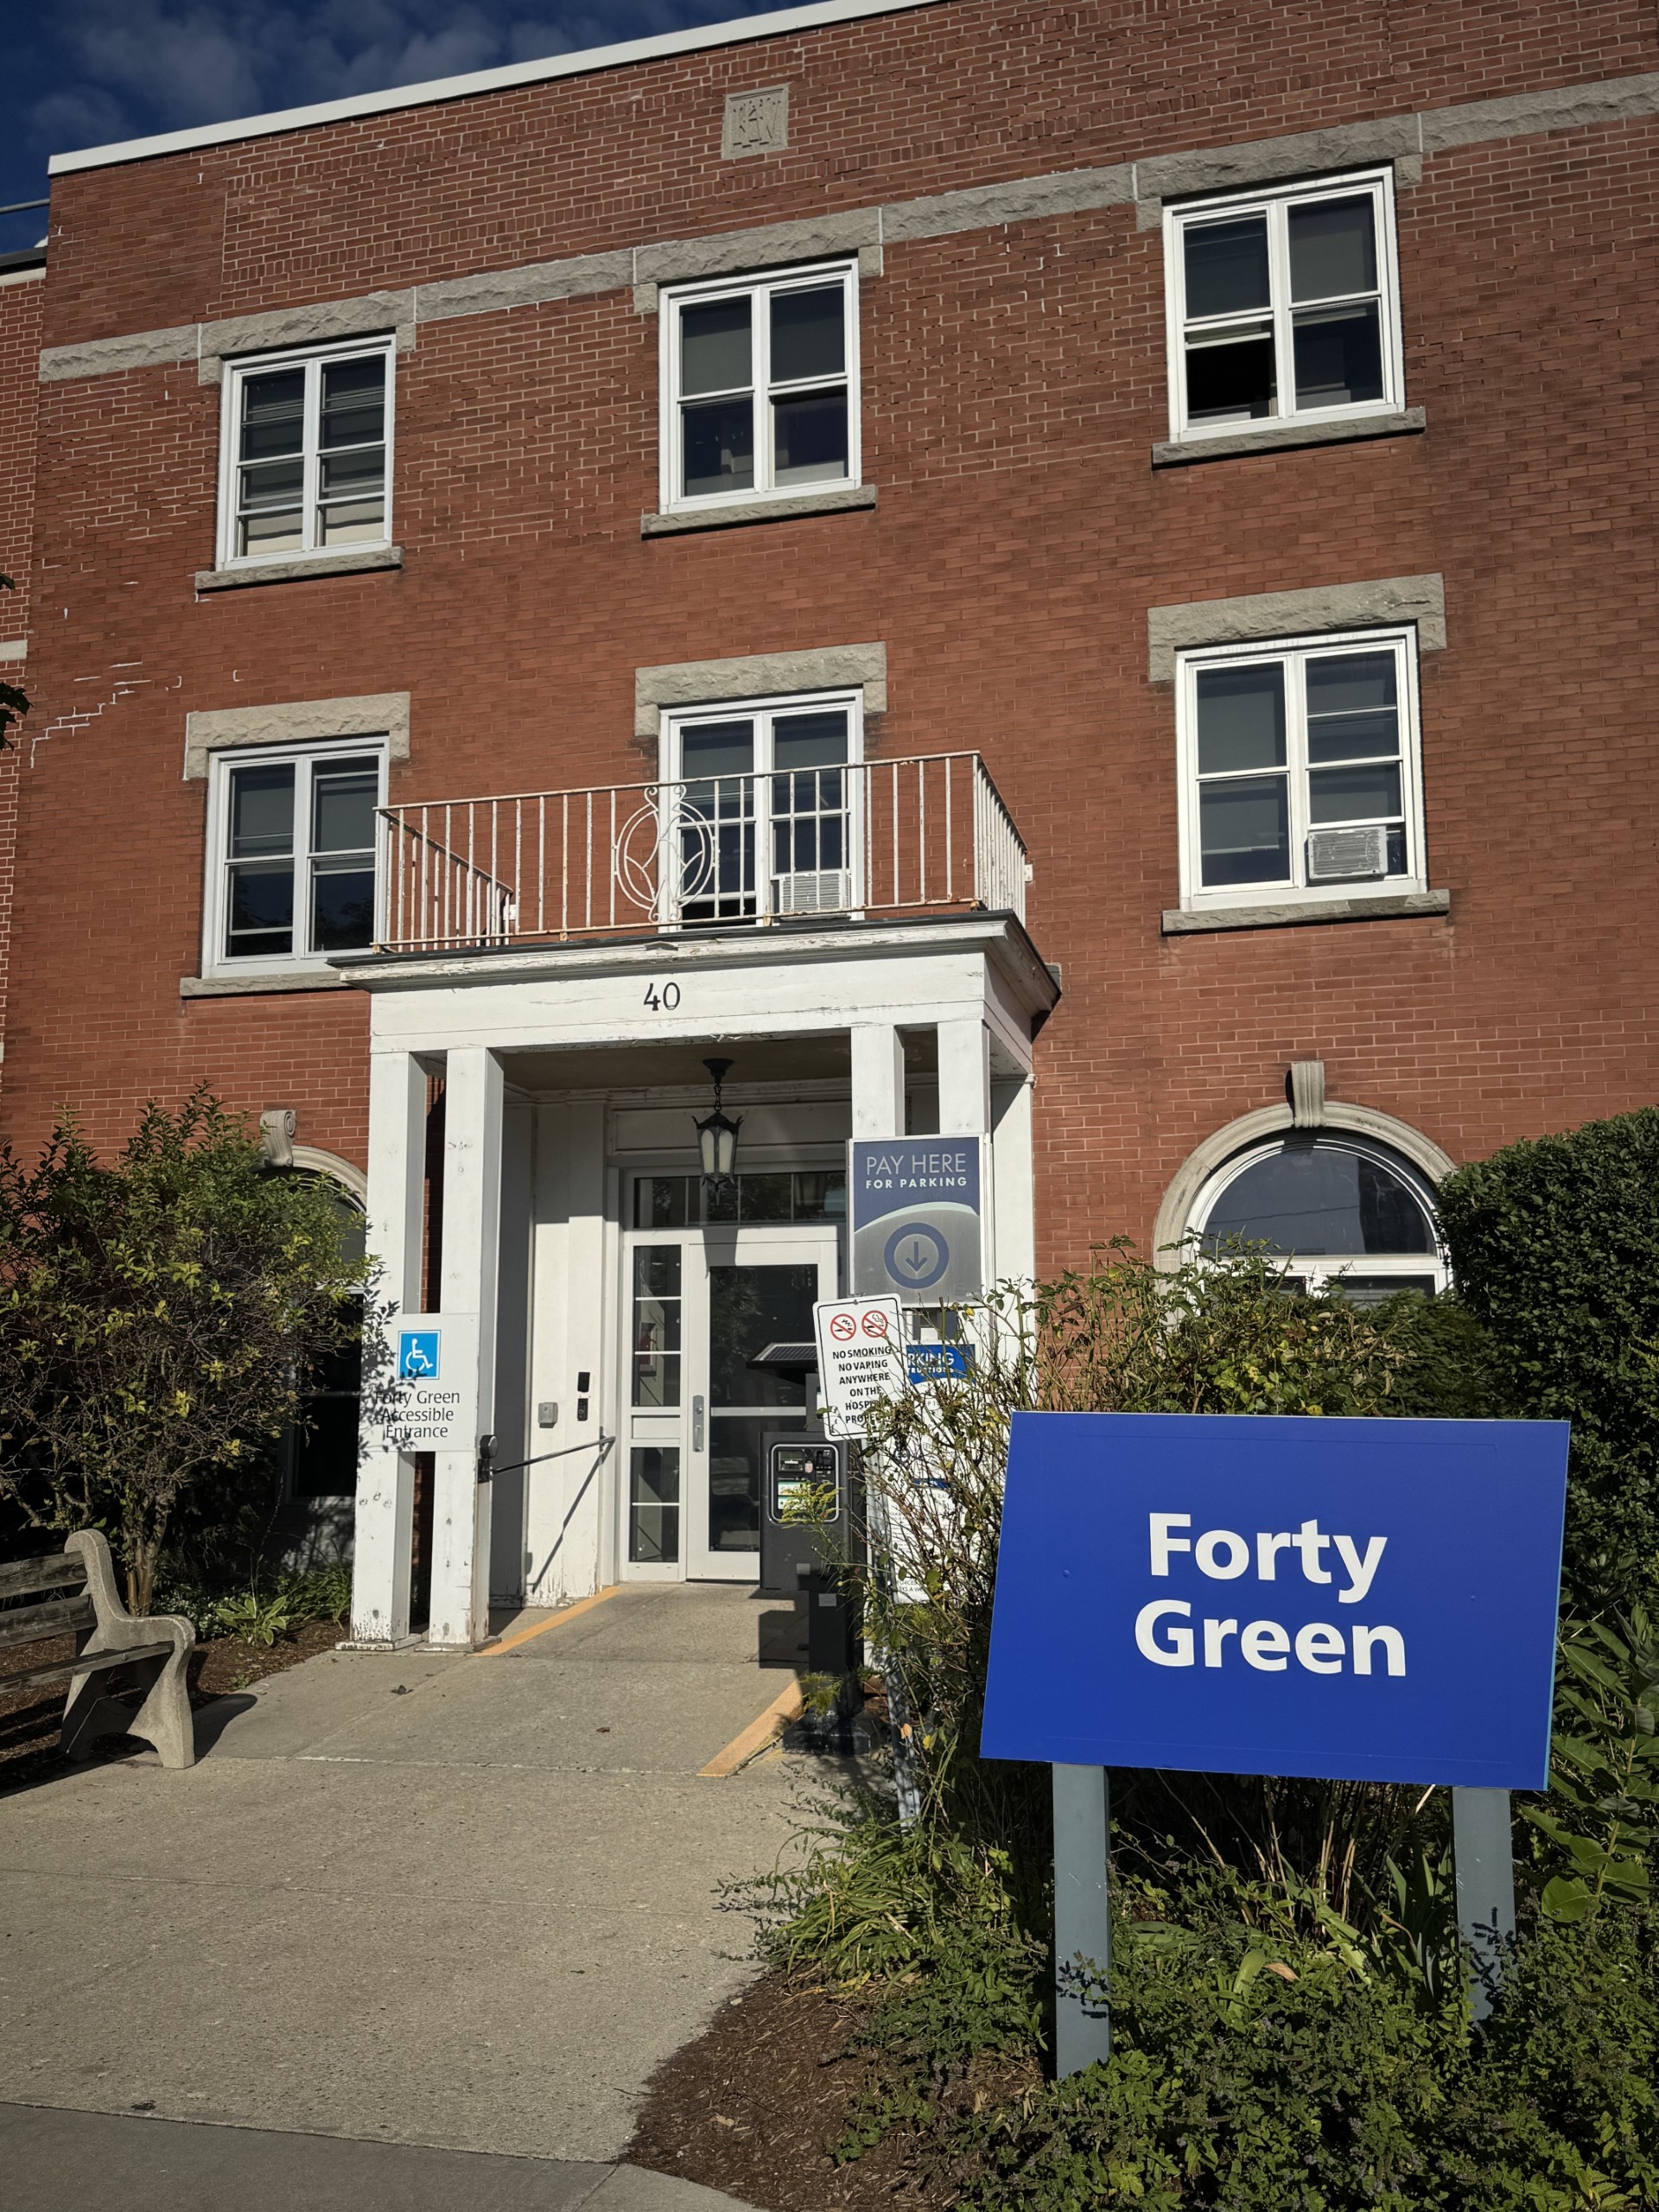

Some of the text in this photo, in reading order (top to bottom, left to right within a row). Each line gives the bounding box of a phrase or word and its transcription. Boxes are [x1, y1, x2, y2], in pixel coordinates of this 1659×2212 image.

[644, 982, 681, 1011] 40
[867, 1153, 966, 1175] PAY HERE
[866, 1176, 967, 1189] FOR PARKING
[832, 1345, 892, 1359] NO SMOKING
[907, 1352, 955, 1366] RKING
[838, 1359, 888, 1371] NO VAPING
[839, 1372, 891, 1385] ANYWHERE
[849, 1386, 881, 1396] ON THE
[374, 1390, 460, 1408] Forty Green
[381, 1407, 454, 1421] Accessible
[386, 1424, 448, 1438] Entrance
[1148, 1512, 1388, 1604] Forty
[1135, 1599, 1407, 1677] Green
